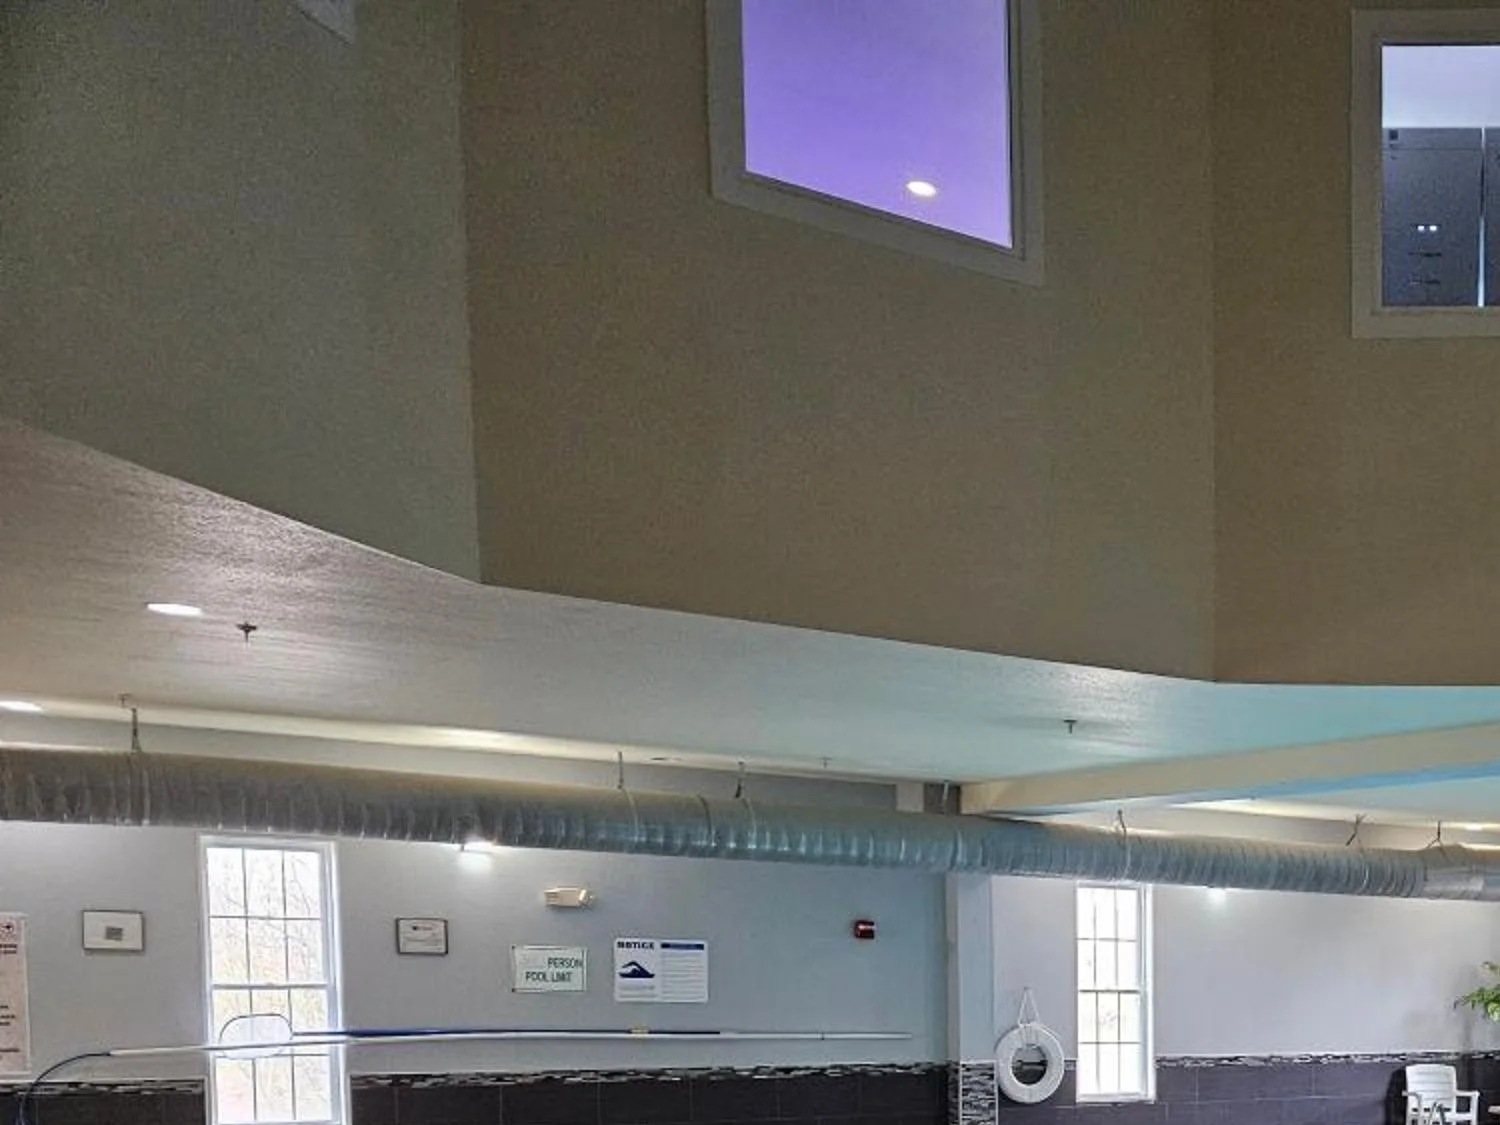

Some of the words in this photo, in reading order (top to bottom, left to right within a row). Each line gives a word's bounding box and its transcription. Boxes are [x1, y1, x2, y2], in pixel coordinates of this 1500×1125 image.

[617, 941, 655, 951] NOTICE
[547, 957, 583, 969] PERSON
[525, 971, 548, 982] POOL
[551, 971, 573, 982] LIMIT
